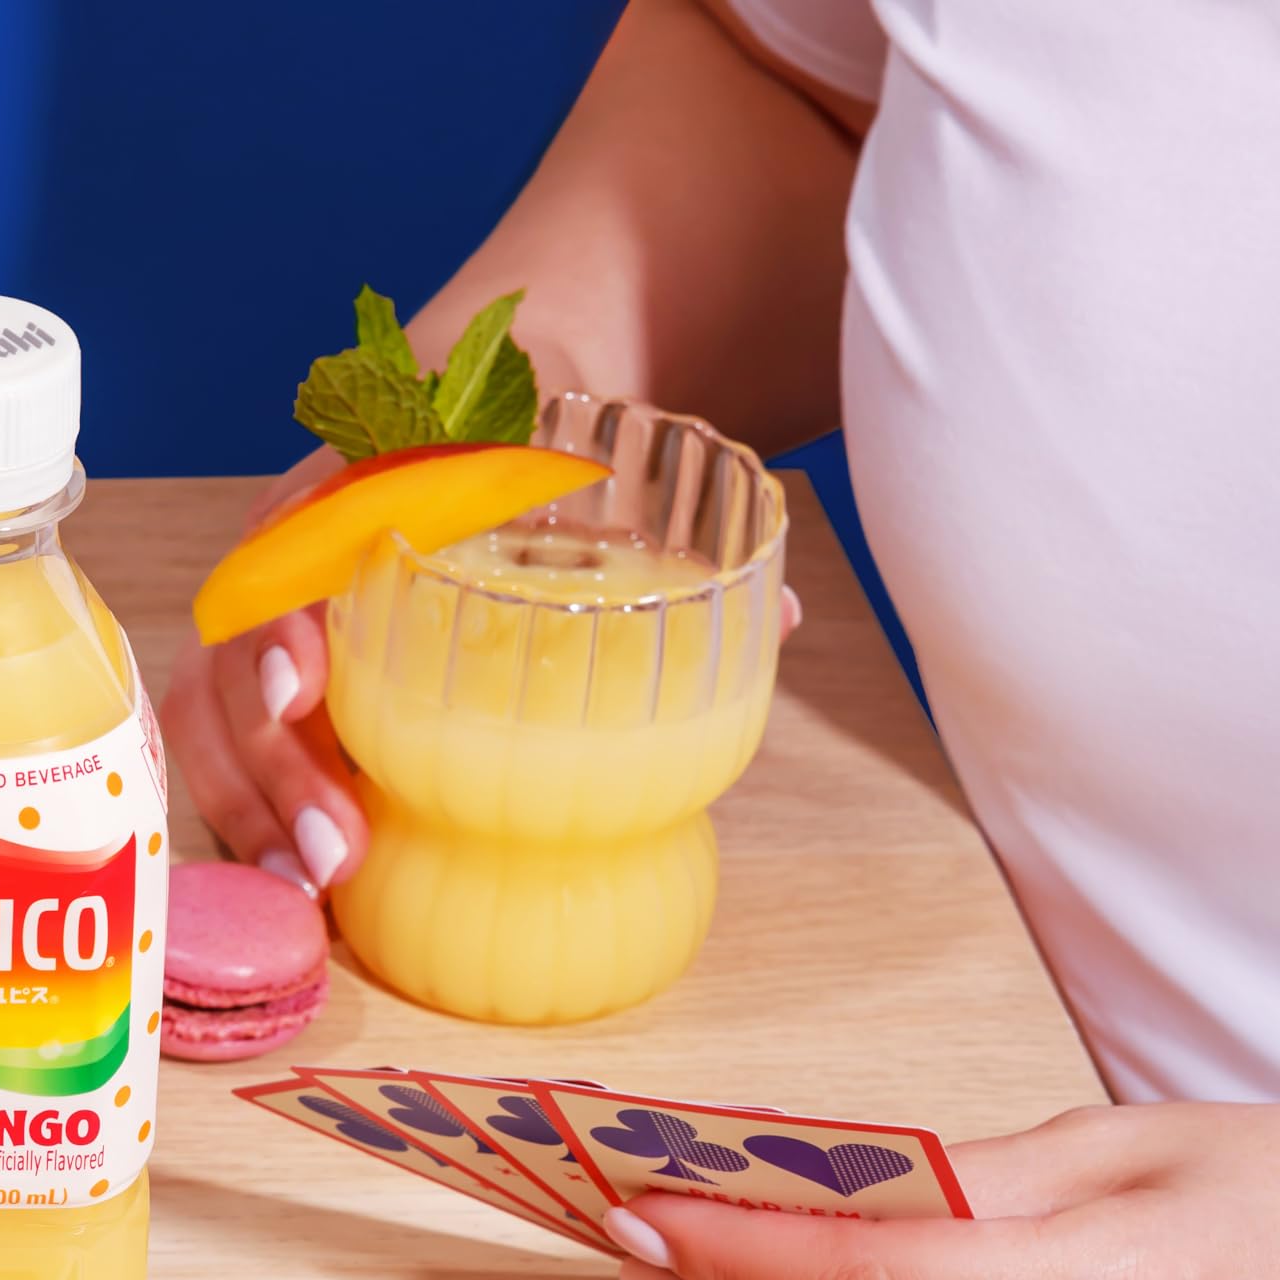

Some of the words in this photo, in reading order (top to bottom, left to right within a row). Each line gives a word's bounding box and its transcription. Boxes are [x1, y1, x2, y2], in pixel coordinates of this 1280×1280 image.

[15, 754, 104, 787] BEVERAGE
[46, 1145, 105, 1172] Flavored
[26, 1187, 68, 1205] mL)
